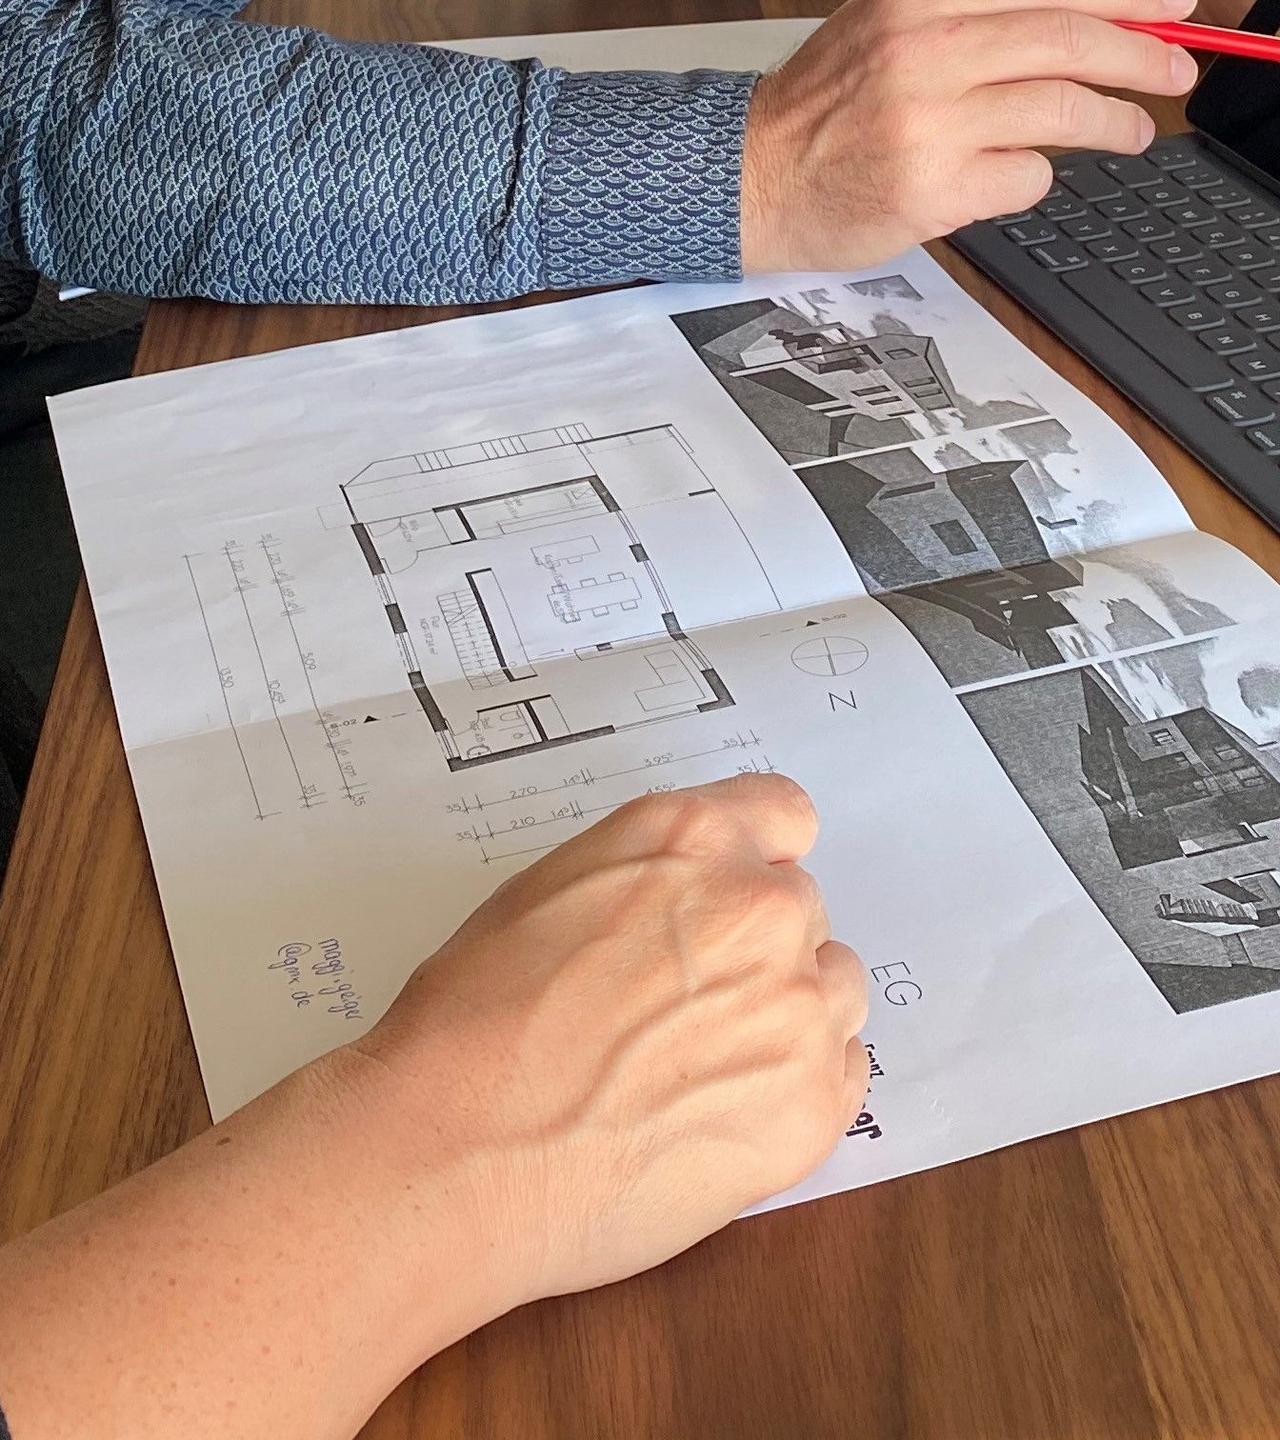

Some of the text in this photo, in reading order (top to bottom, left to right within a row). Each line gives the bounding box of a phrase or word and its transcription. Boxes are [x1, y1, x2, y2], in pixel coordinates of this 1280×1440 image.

[1217, 336, 1234, 344] N
[1249, 361, 1266, 370] M
[828, 690, 857, 712] N
[871, 961, 923, 1006] EG
